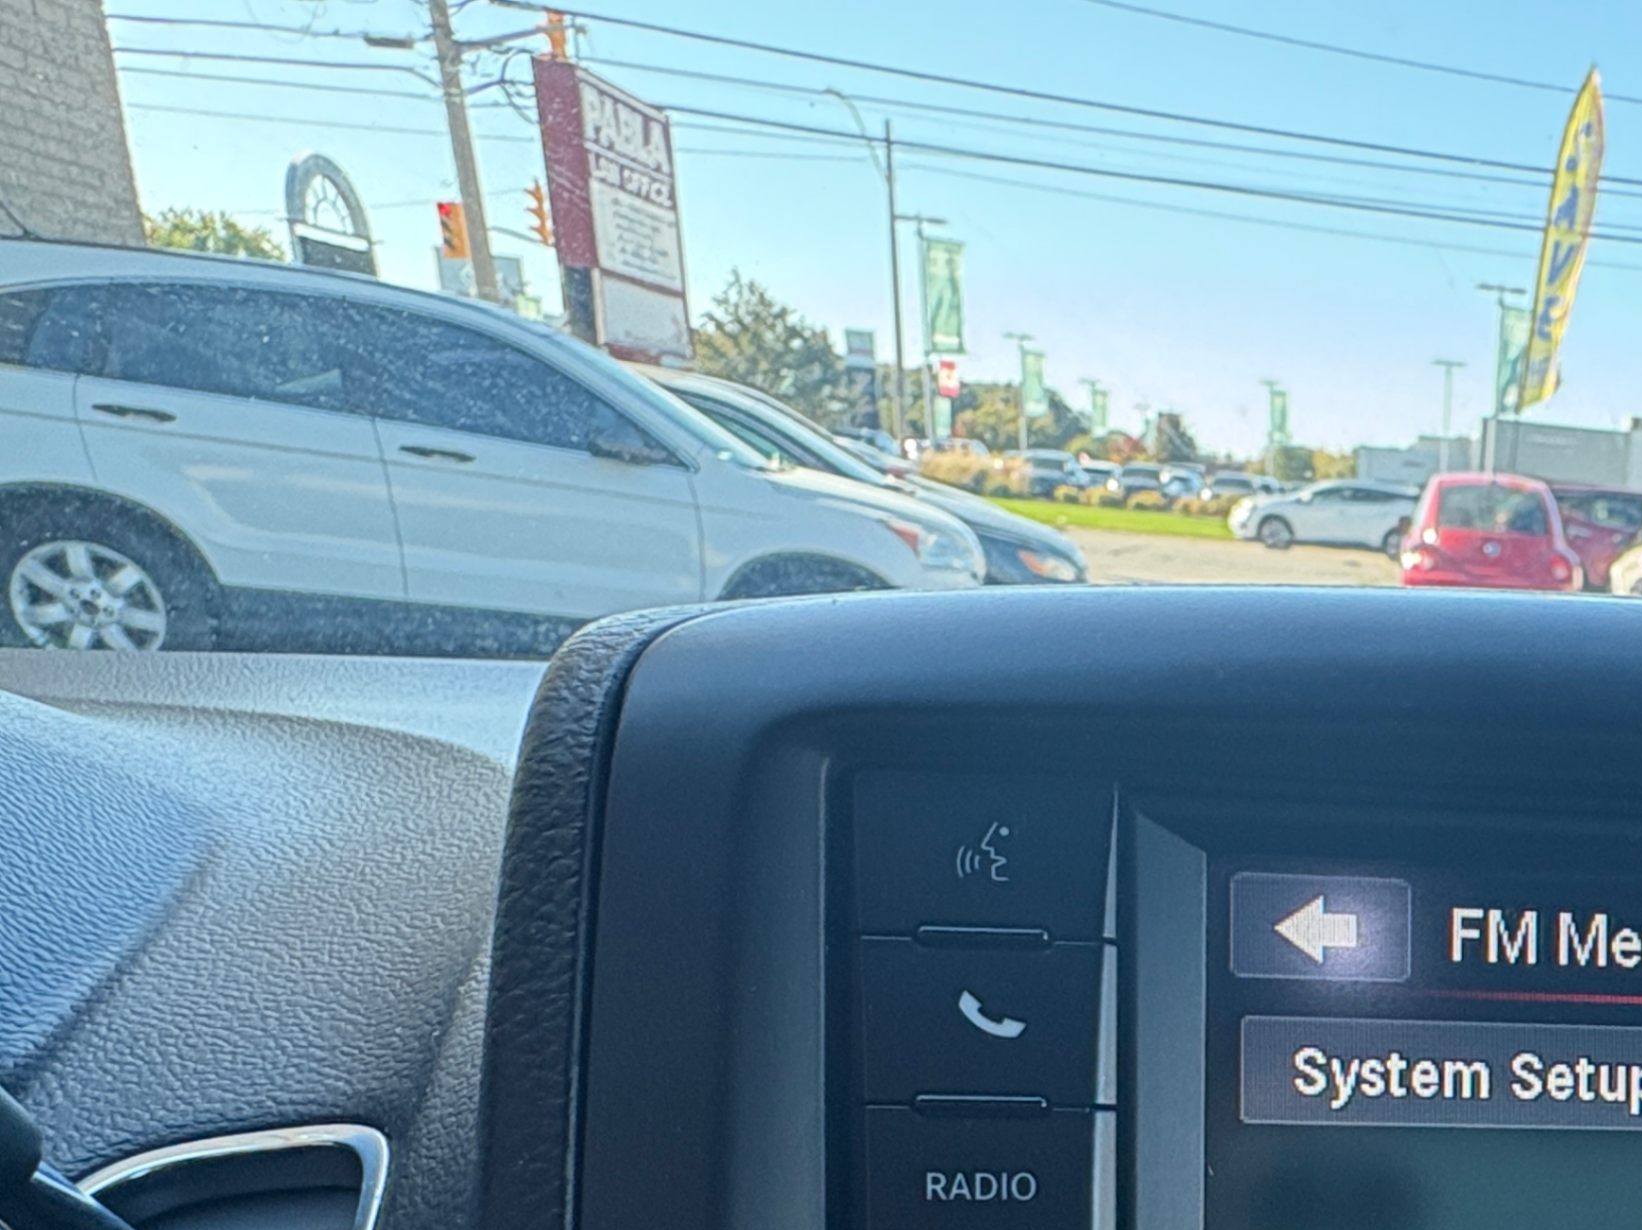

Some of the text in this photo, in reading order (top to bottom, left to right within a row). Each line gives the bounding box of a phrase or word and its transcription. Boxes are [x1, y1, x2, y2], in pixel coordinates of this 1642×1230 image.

[580, 81, 671, 175] PABLA
[1450, 907, 1538, 965] FM
[1292, 1047, 1491, 1110] System
[924, 1172, 1037, 1202] RADIO
